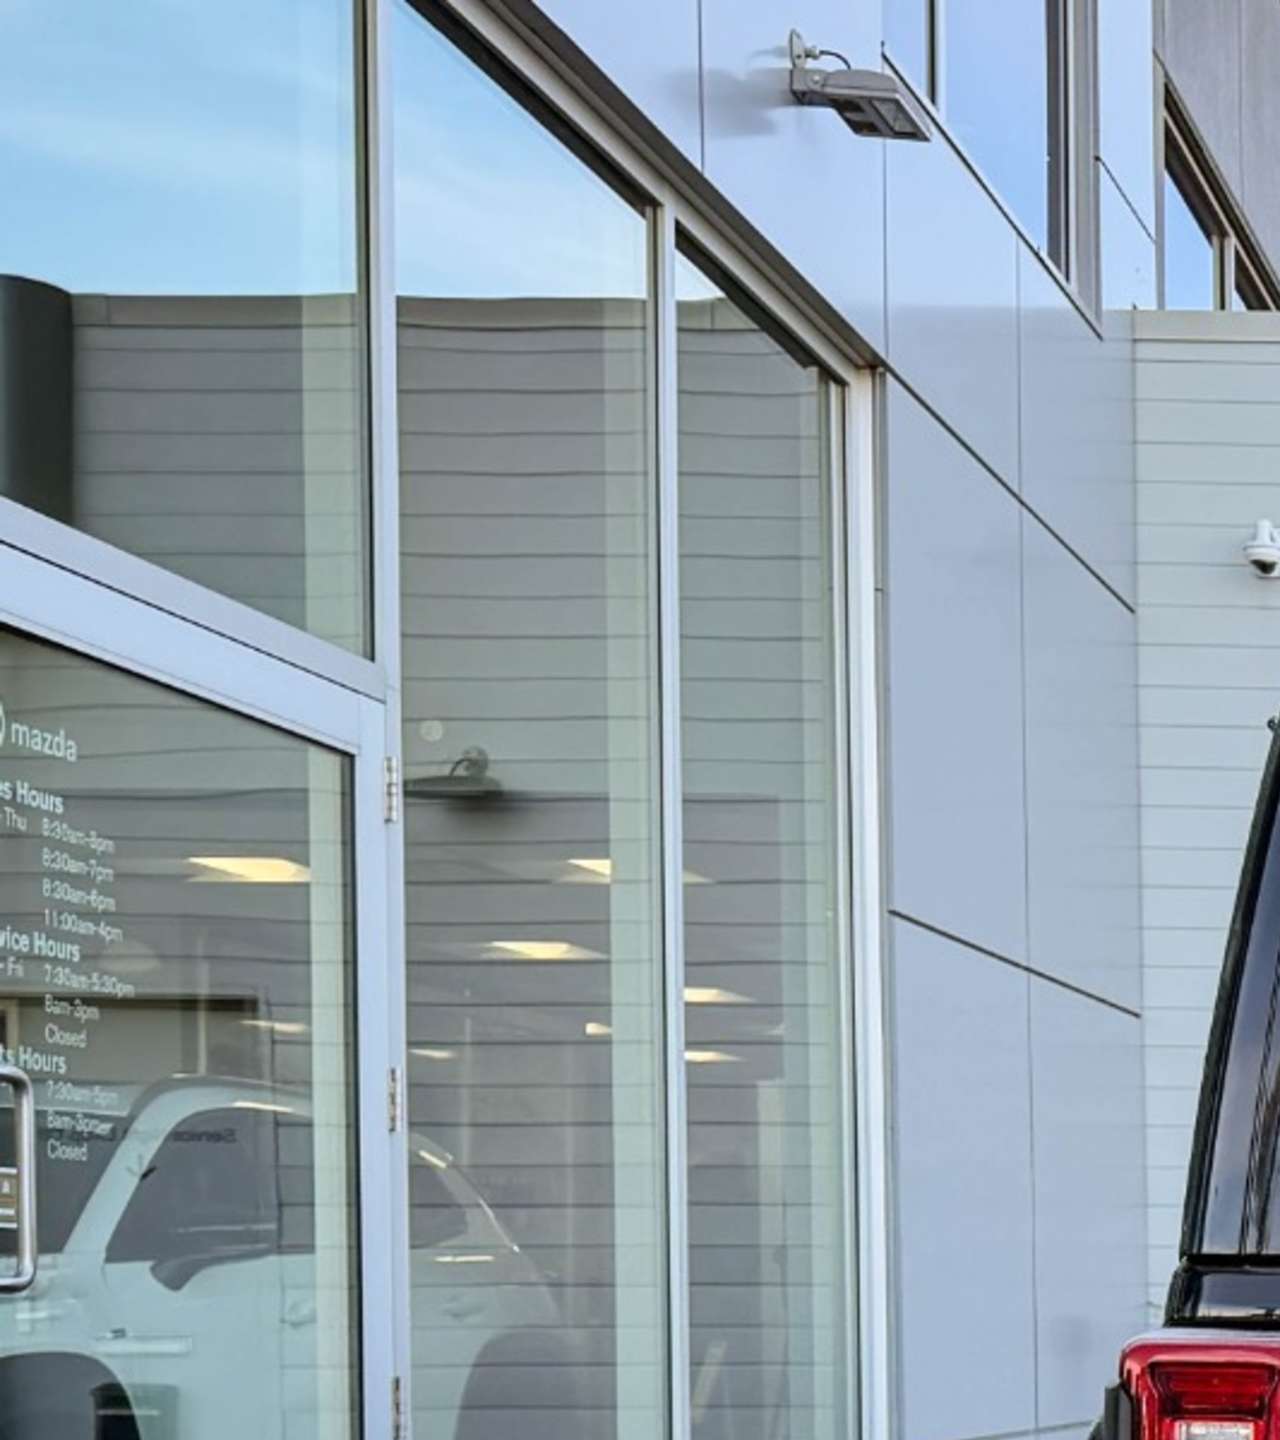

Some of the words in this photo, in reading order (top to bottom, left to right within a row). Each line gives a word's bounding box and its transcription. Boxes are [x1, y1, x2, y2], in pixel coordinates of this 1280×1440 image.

[11, 723, 78, 762] mazda
[16, 779, 64, 815] Hours
[33, 931, 80, 962] Hours
[45, 1022, 88, 1049] Closed
[19, 1045, 67, 1075] Hours
[47, 1138, 88, 1161] Closed
